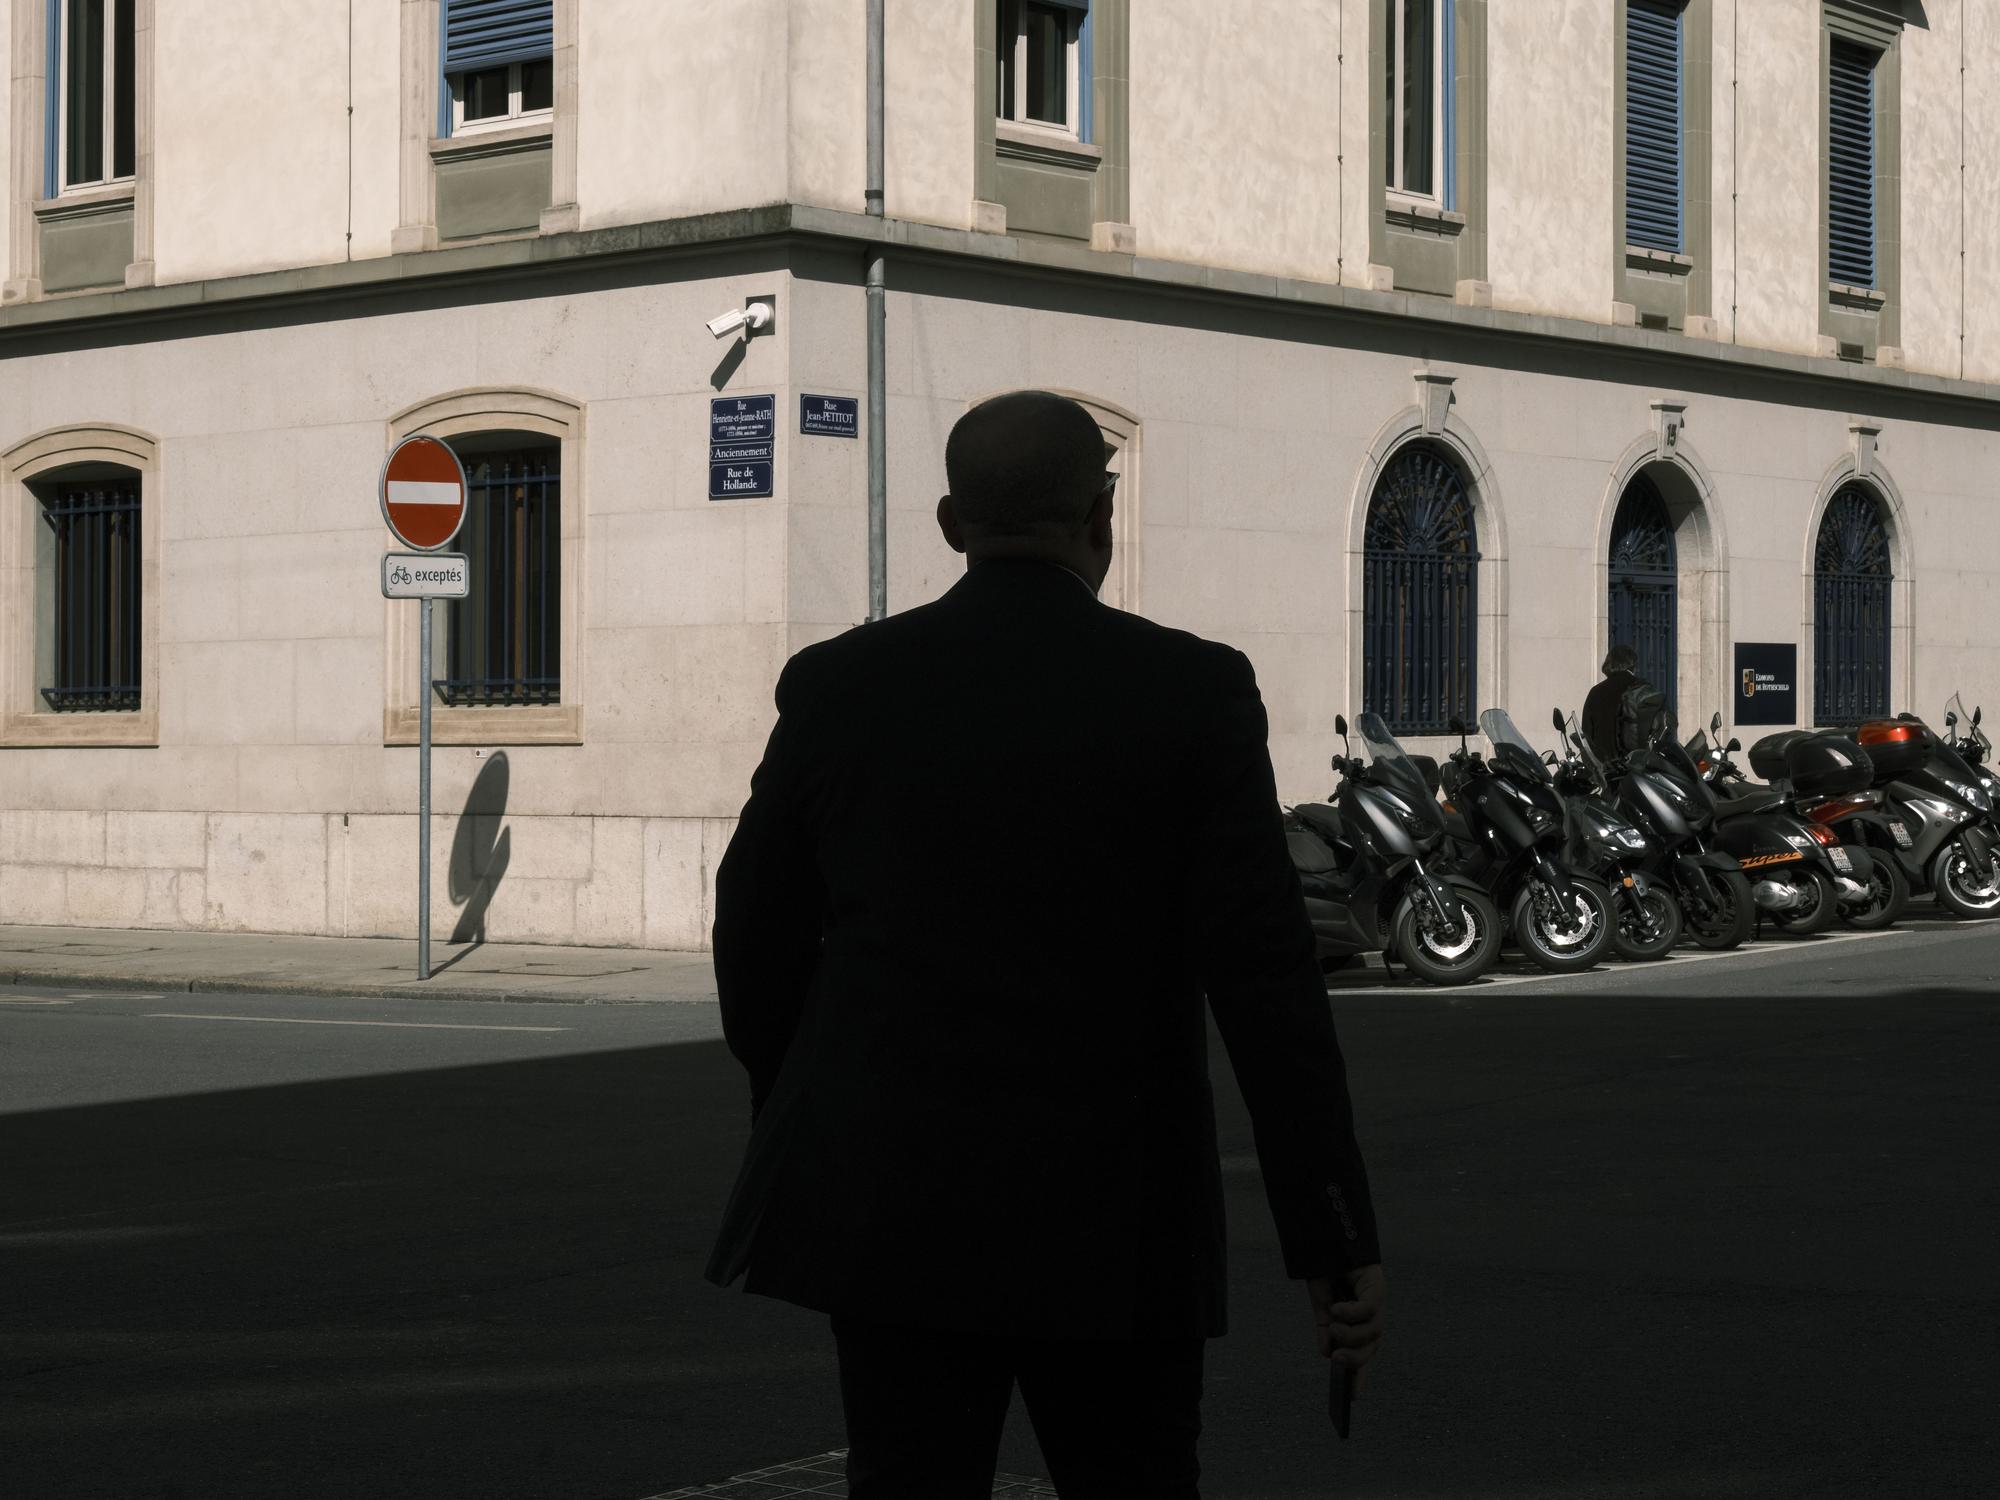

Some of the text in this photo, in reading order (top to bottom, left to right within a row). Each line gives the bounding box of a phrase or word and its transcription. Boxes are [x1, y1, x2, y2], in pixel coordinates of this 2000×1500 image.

[737, 400, 747, 411] Rue
[824, 400, 837, 411] Rue
[806, 410, 854, 424] Jean-PETITOT
[714, 447, 767, 458] Anciennement
[727, 467, 754, 478] Rue de
[723, 479, 758, 490] Hollande
[415, 567, 462, 585] exceptés
